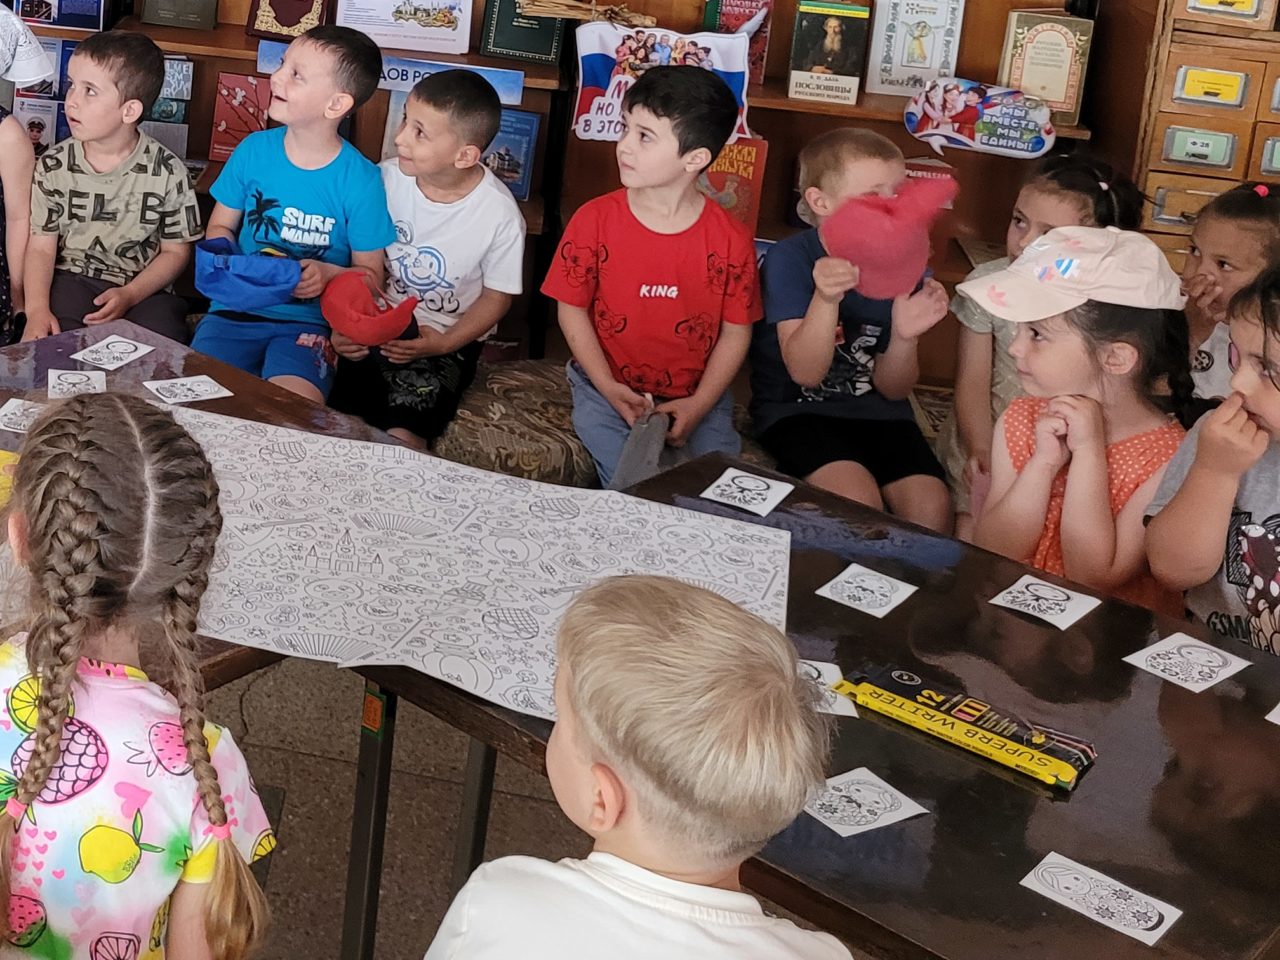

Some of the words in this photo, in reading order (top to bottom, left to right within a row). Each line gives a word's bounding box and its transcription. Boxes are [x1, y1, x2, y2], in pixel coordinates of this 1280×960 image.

[595, 101, 614, 115] НО
[1000, 106, 1025, 118] МЫ
[582, 119, 592, 133] В
[982, 114, 1040, 133] ВМЕСТЕ,
[996, 126, 1021, 138] МЫ
[980, 134, 1034, 152] ЕДИНЫ!
[280, 206, 336, 235] SURF
[639, 283, 679, 300] KING
[866, 688, 958, 730] WRITER
[963, 727, 1052, 769] SUPERB
